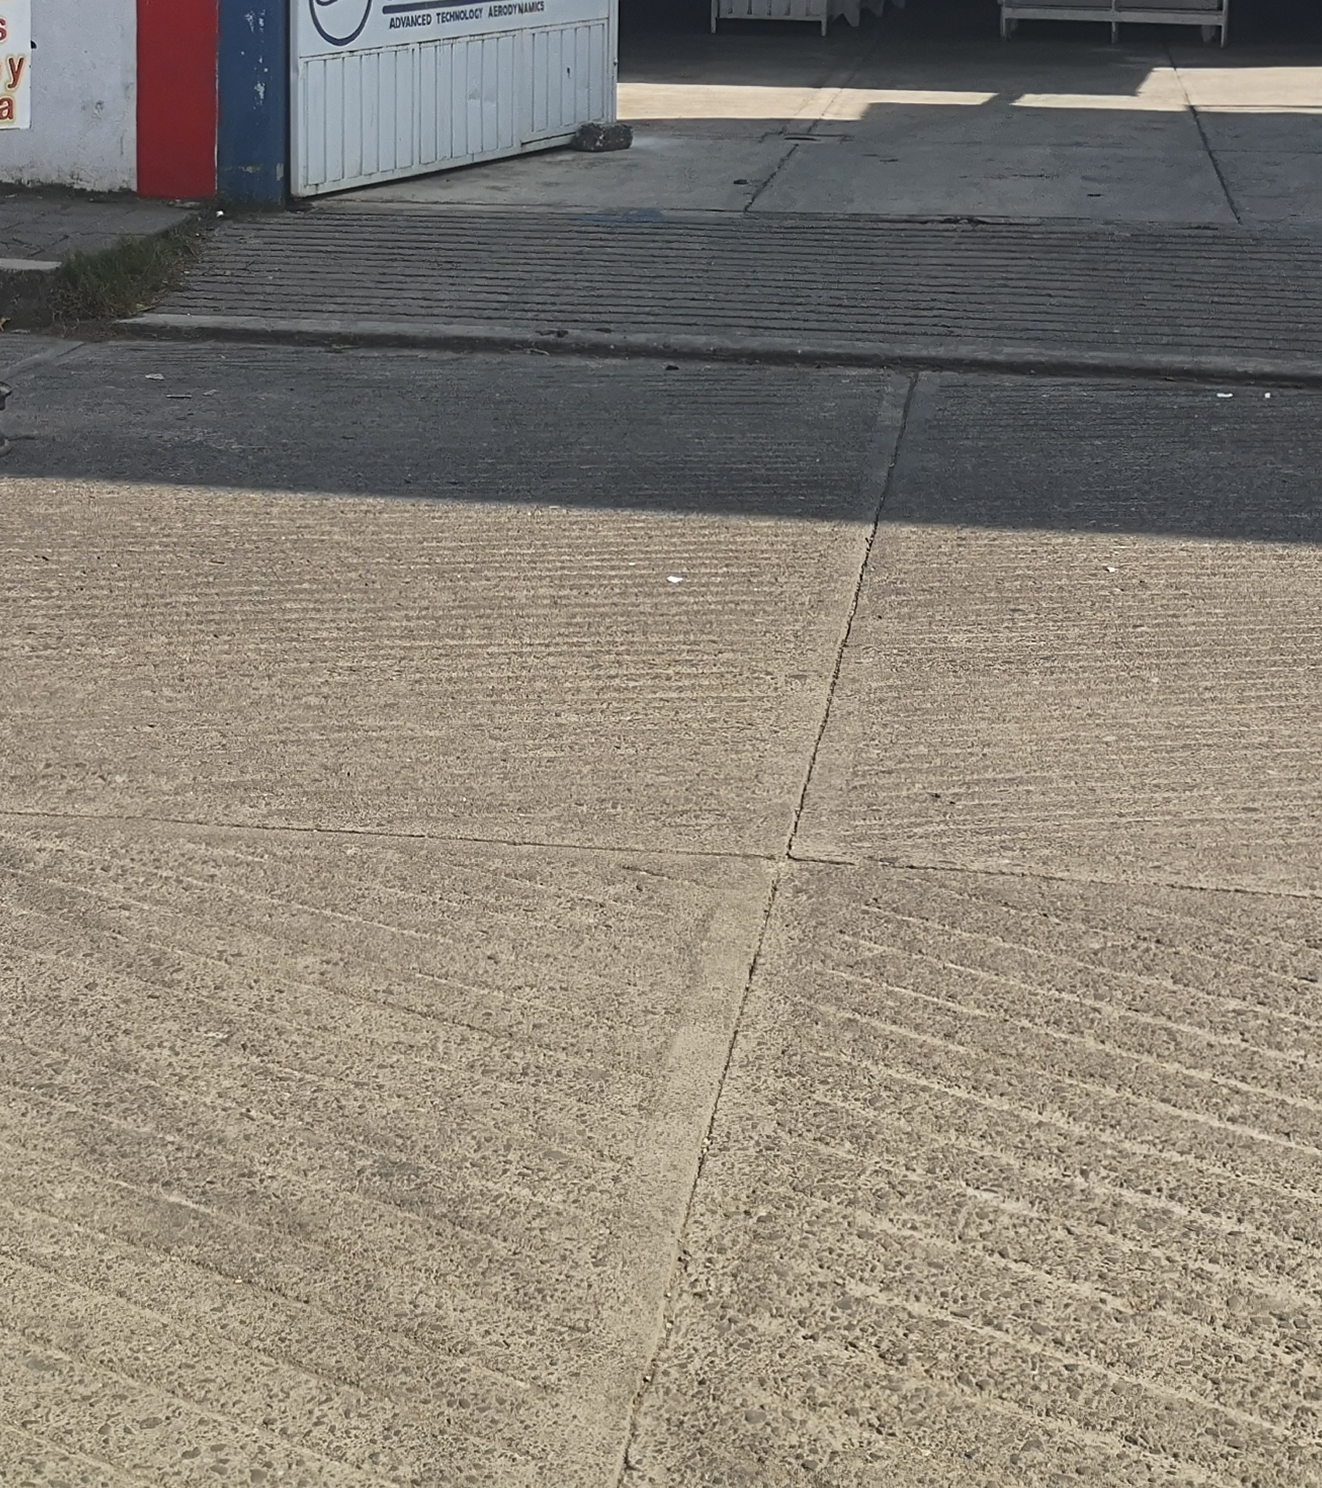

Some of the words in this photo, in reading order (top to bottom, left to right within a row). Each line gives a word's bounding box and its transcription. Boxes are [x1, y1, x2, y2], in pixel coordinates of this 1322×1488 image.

[388, 13, 432, 30] ADVANCED
[436, 7, 484, 23] TECHNOLOGY
[487, 0, 545, 18] AERODYNAMICS
[6, 56, 25, 90] y
